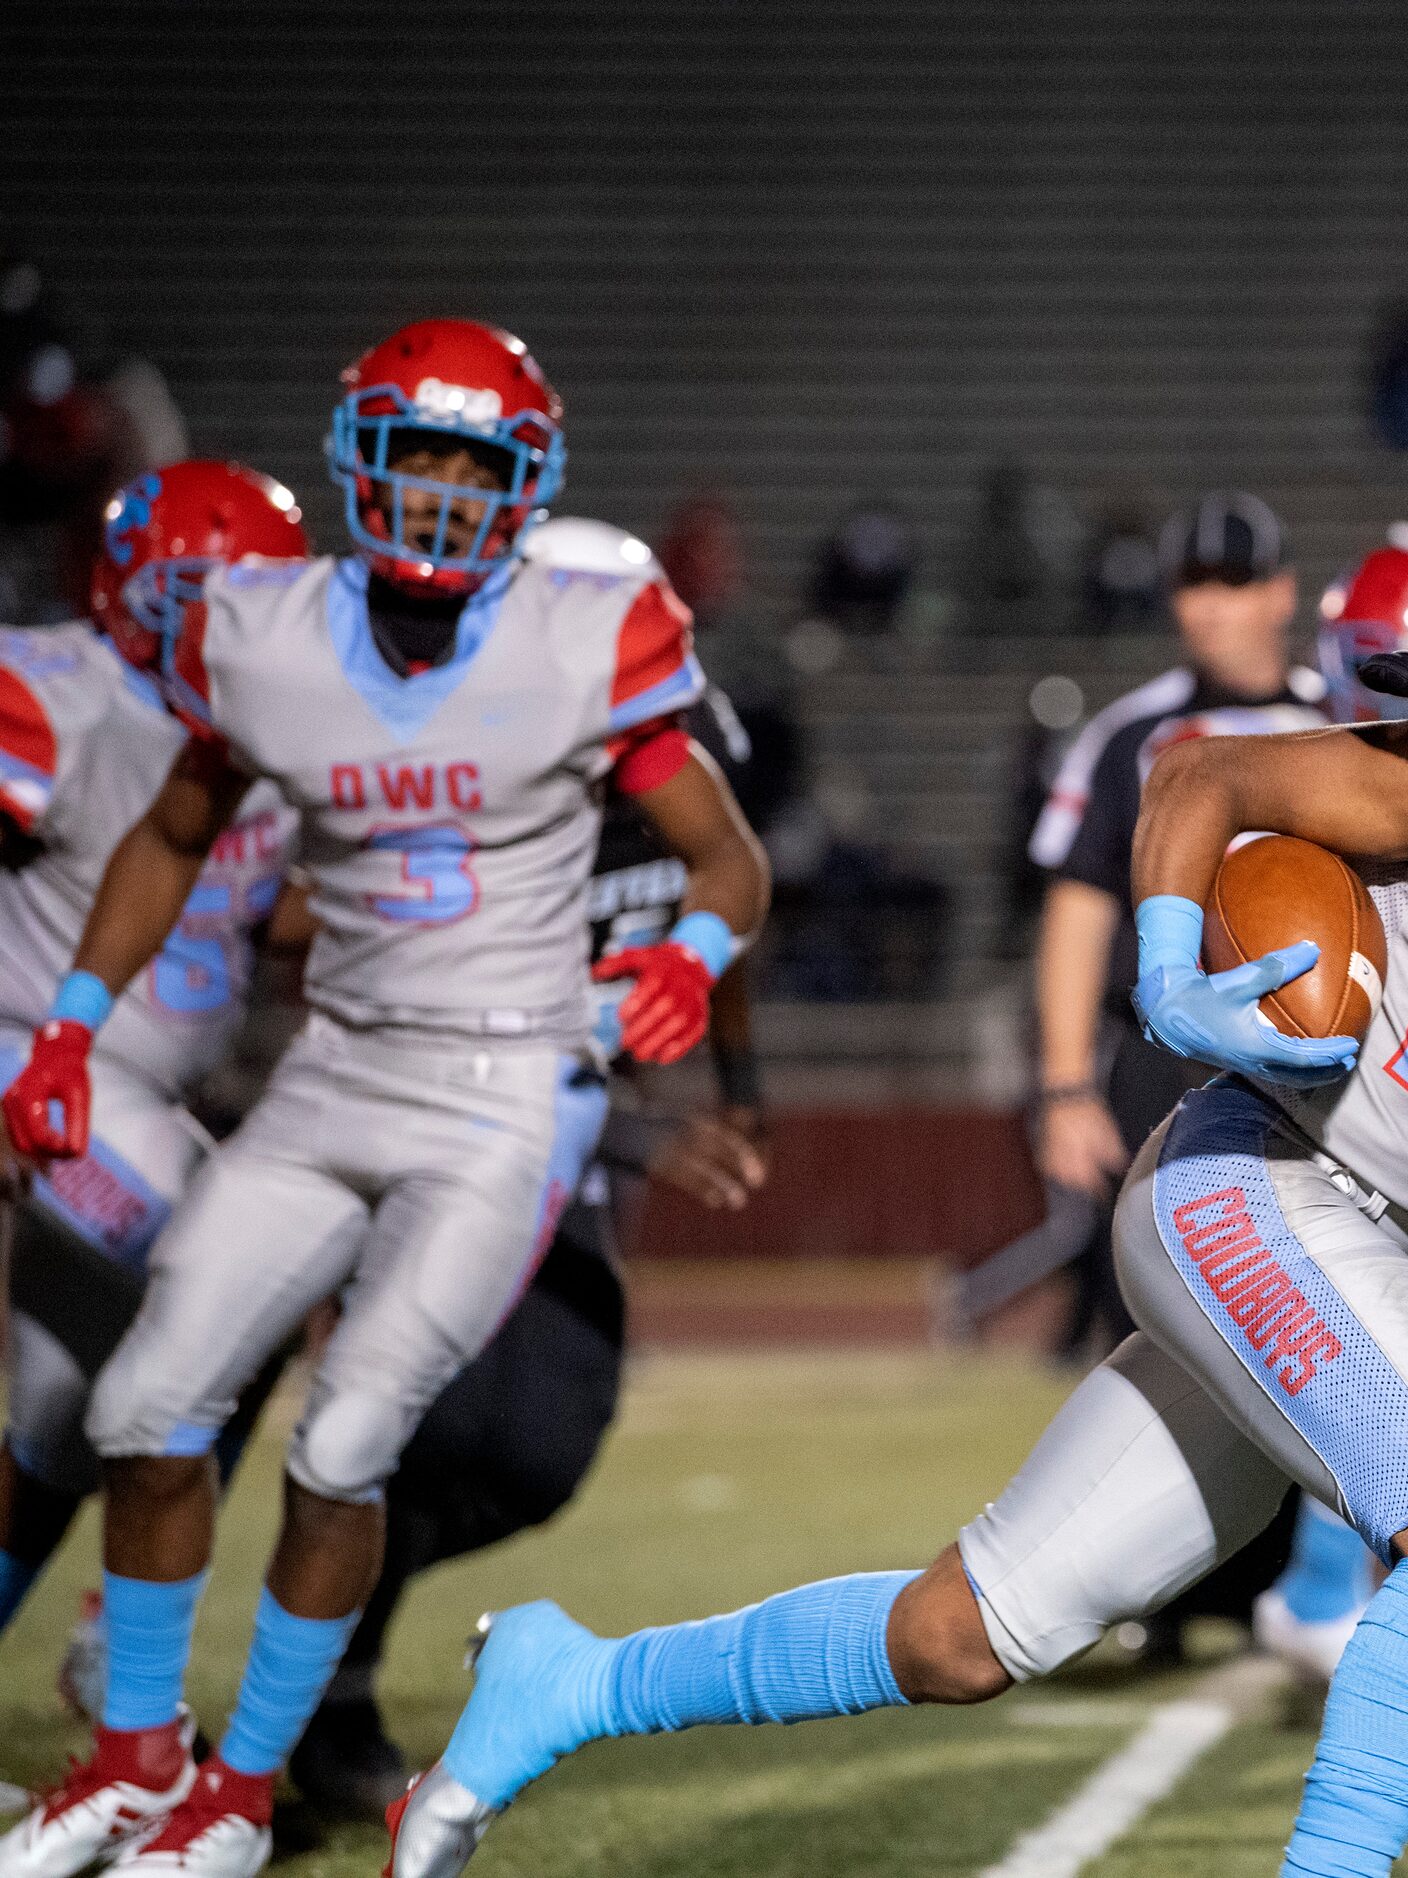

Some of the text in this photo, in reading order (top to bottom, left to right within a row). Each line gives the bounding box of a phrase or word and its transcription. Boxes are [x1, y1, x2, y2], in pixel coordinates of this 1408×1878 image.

[330, 763, 483, 813] DWC
[362, 819, 484, 930] 3
[1173, 1186, 1344, 1397] COWBOYS
